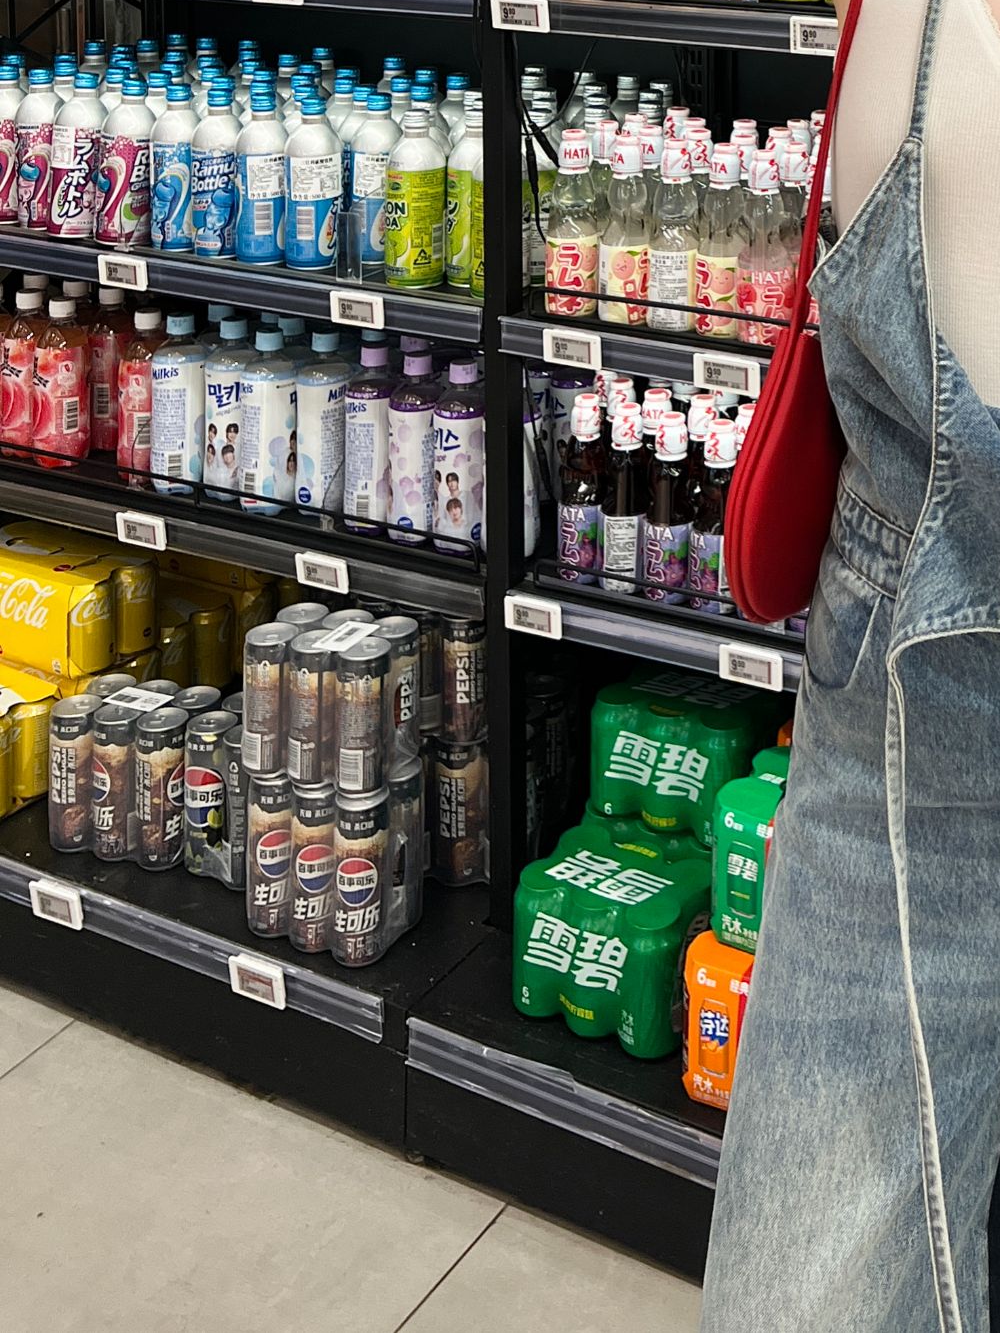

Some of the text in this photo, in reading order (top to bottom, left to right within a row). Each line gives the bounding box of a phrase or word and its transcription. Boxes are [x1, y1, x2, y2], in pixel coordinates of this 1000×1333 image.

[563, 147, 590, 160] HATA
[152, 367, 180, 382] Milkis
[456, 650, 471, 705] PEPSI
[51, 745, 62, 805] PEPSI
[604, 729, 710, 803] 雪碧
[439, 774, 451, 839] PEPSI
[603, 802, 613, 816] 6
[723, 811, 736, 830] 6
[544, 849, 676, 906] 雪碧
[726, 852, 759, 883] 雪碧
[337, 875, 376, 887] 百事可乐
[334, 900, 382, 935] 生可乐
[721, 913, 743, 934] 汽水
[522, 911, 630, 993] 雪碧
[696, 967, 708, 986] 6
[521, 985, 530, 998] 6
[699, 1008, 730, 1039] 芬达
[692, 1073, 715, 1095] 汽水
